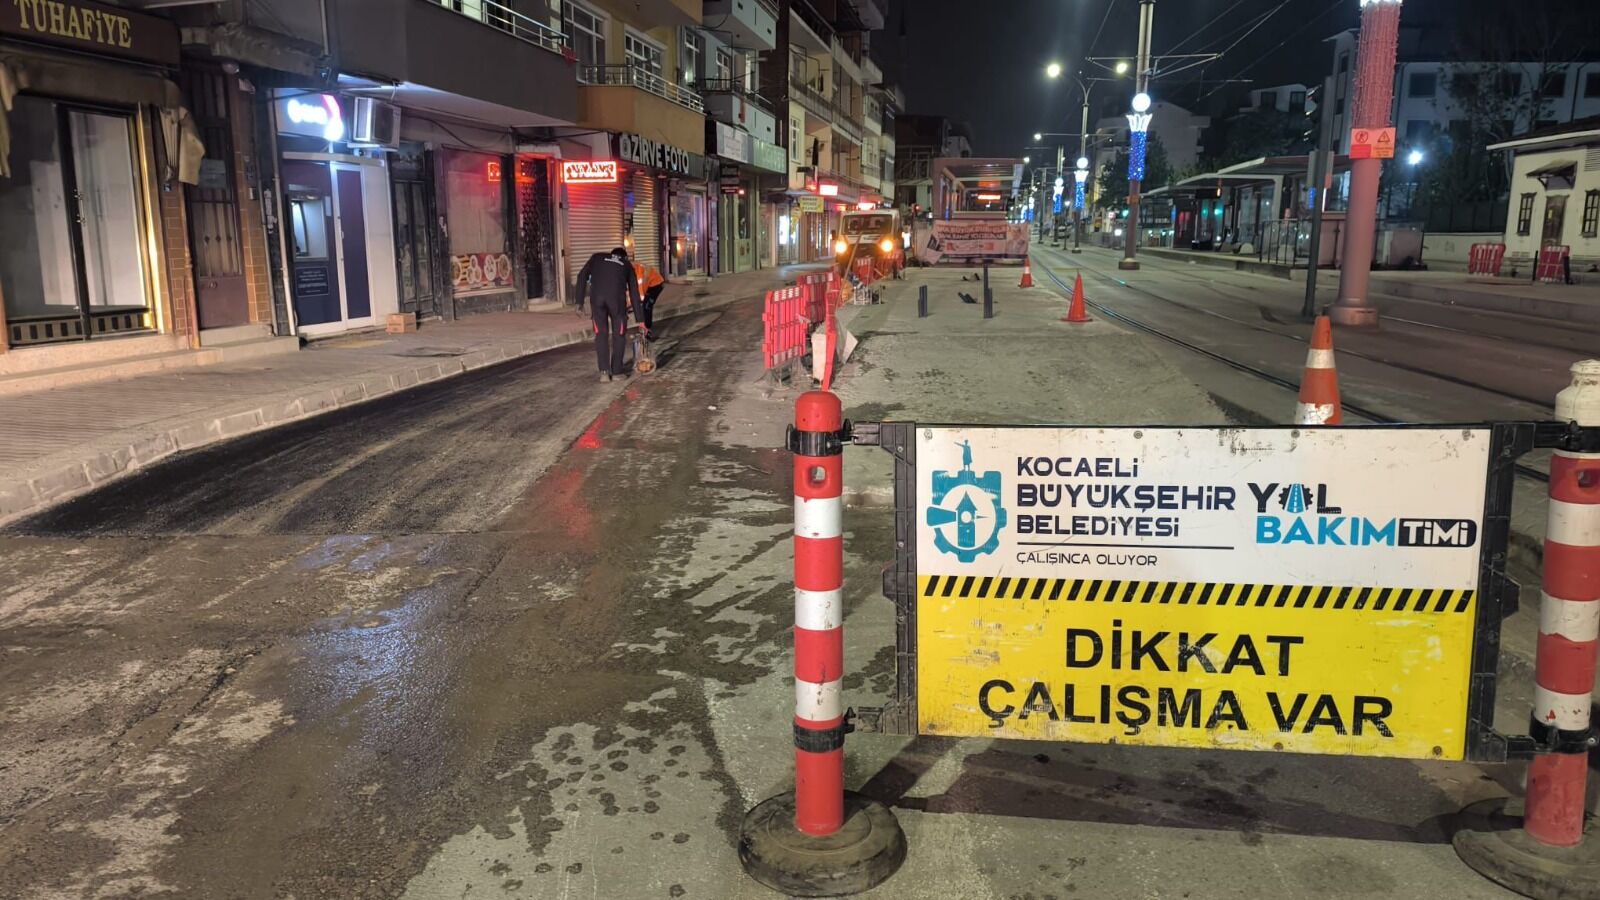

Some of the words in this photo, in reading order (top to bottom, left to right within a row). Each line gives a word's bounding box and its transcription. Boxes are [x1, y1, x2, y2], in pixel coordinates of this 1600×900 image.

[664, 145, 689, 174] FOTO
[1255, 515, 1397, 547] BAKIM
[1016, 551, 1091, 565] ÇALIŞINCA
[1096, 553, 1158, 566] OLUYOR
[1065, 619, 1305, 677] DİKKAT
[978, 679, 1250, 736] ÇALIŞMA
[1266, 691, 1394, 738] VAR
